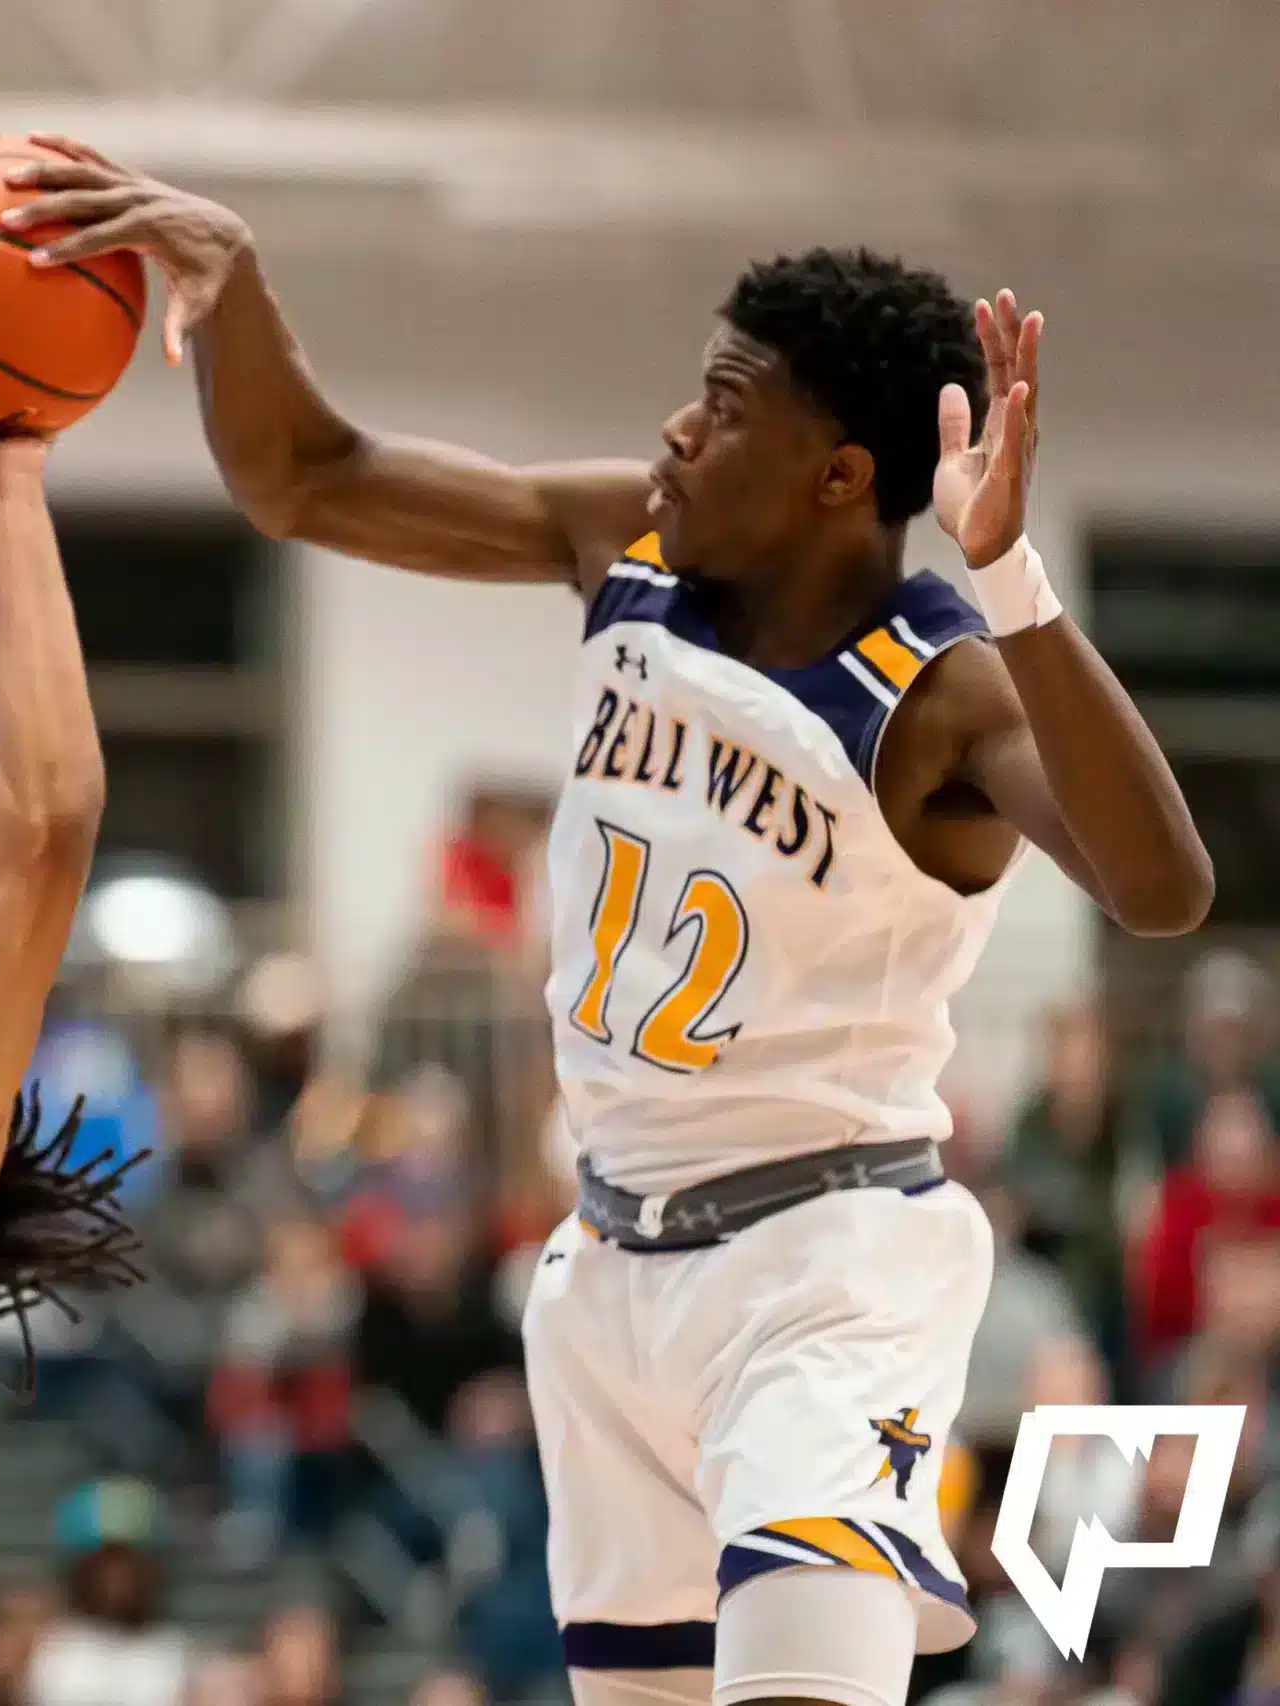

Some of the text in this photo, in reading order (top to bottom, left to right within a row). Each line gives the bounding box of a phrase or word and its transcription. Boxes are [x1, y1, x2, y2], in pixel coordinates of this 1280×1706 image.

[573, 684, 838, 888] BELL WEST
[569, 816, 750, 1075] 12
